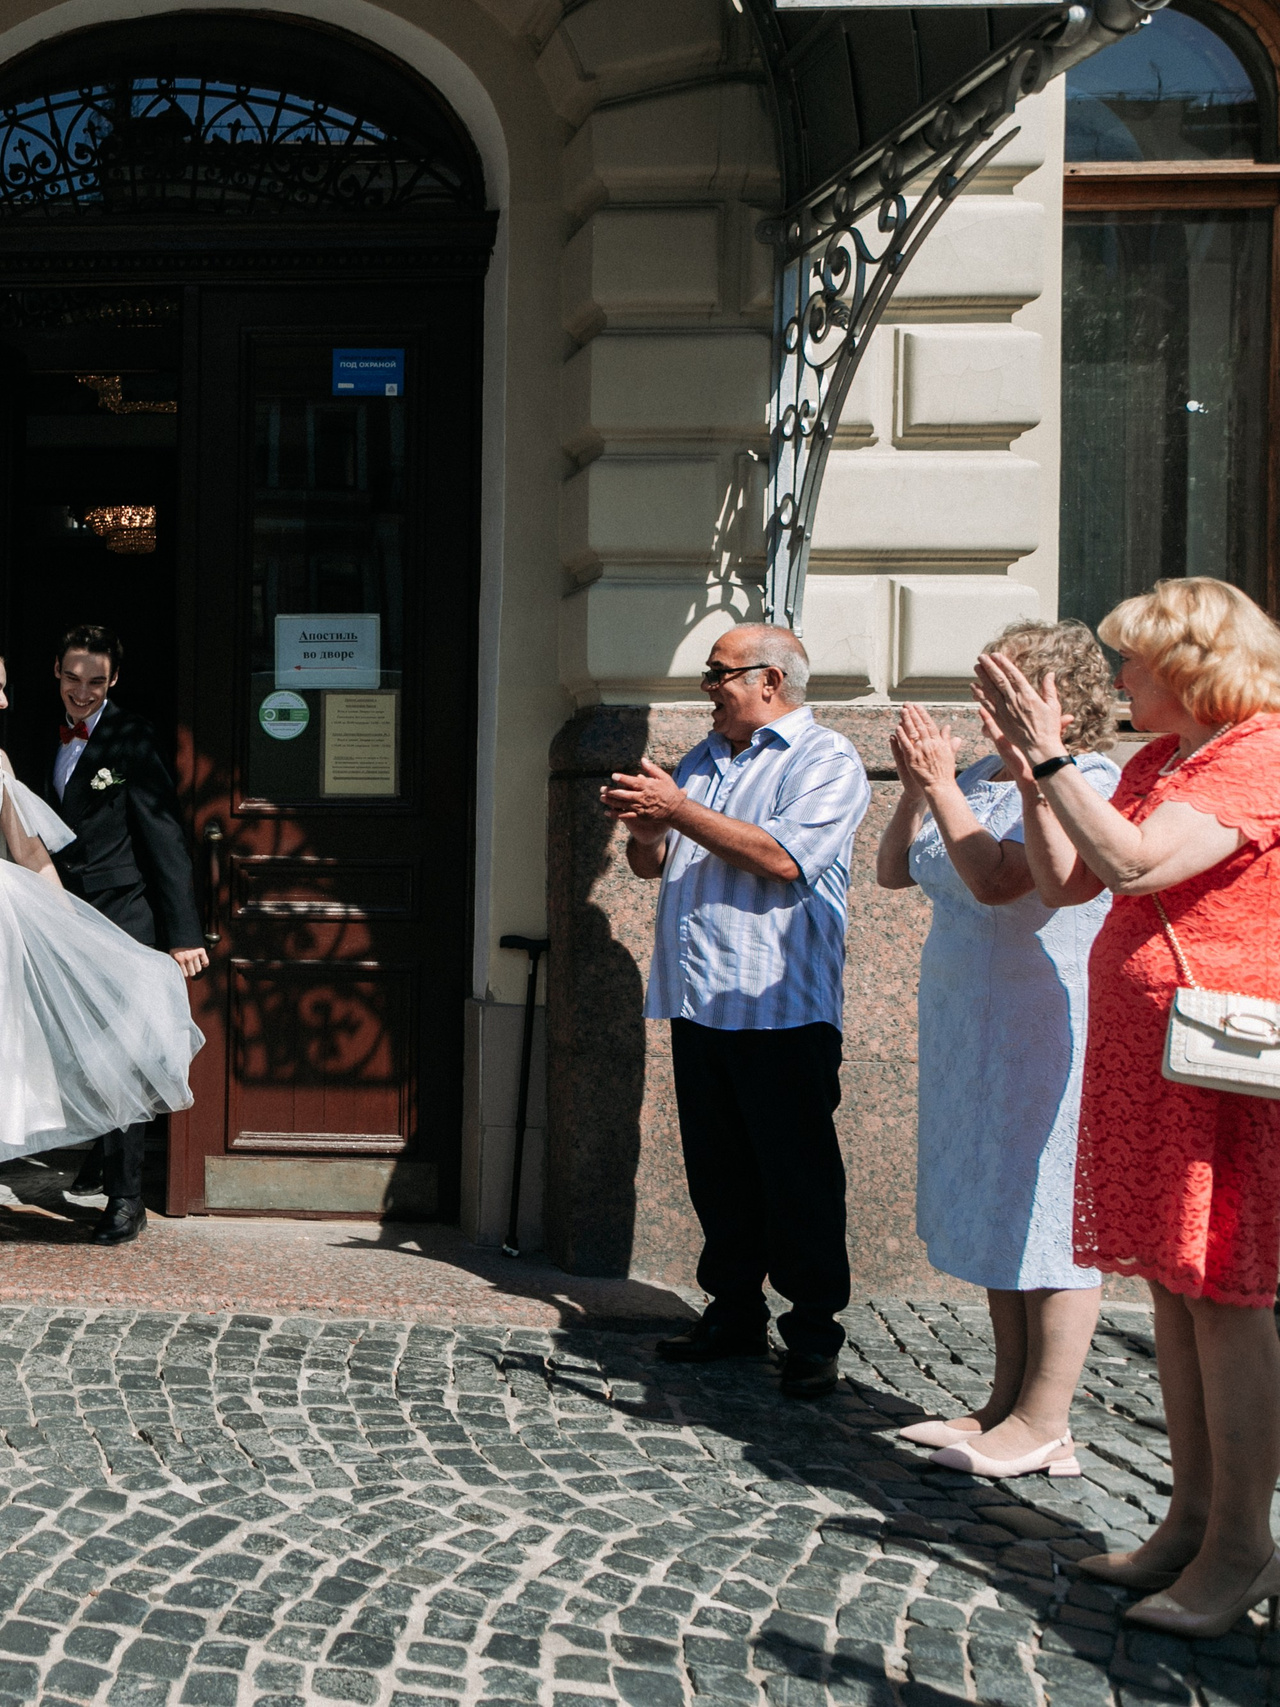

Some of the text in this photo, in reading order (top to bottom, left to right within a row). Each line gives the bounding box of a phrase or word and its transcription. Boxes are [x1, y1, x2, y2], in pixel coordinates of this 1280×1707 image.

[339, 360, 397, 369] ПОД ОХРАНОЙ
[299, 631, 358, 641] Апостиль
[303, 650, 355, 661] во дворе
